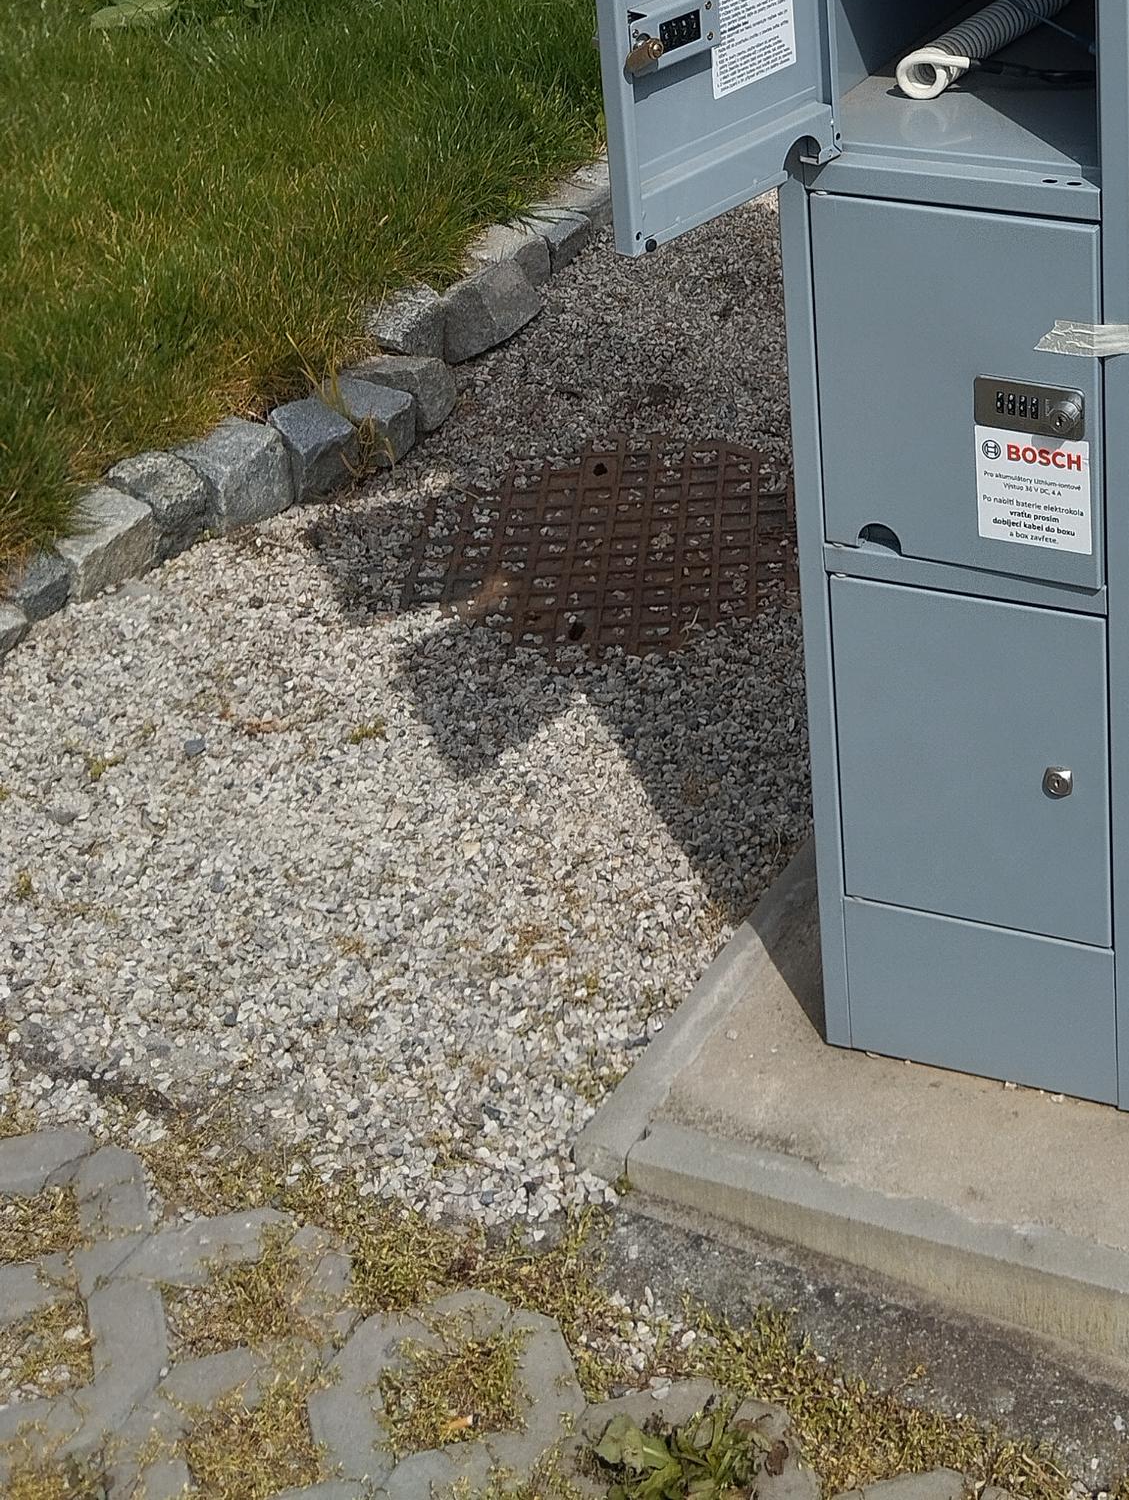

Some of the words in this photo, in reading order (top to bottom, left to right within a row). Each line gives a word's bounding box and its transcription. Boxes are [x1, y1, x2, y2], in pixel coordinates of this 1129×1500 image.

[1006, 443, 1082, 471] BOSCH
[983, 470, 994, 478] Pro
[982, 494, 992, 502] Po
[1016, 499, 1042, 510] baterie
[1043, 504, 1084, 517] elektrokola
[1015, 530, 1029, 540] box
[1023, 521, 1044, 531] kabel
[1045, 524, 1056, 533] do
[1056, 527, 1076, 537] boxu
